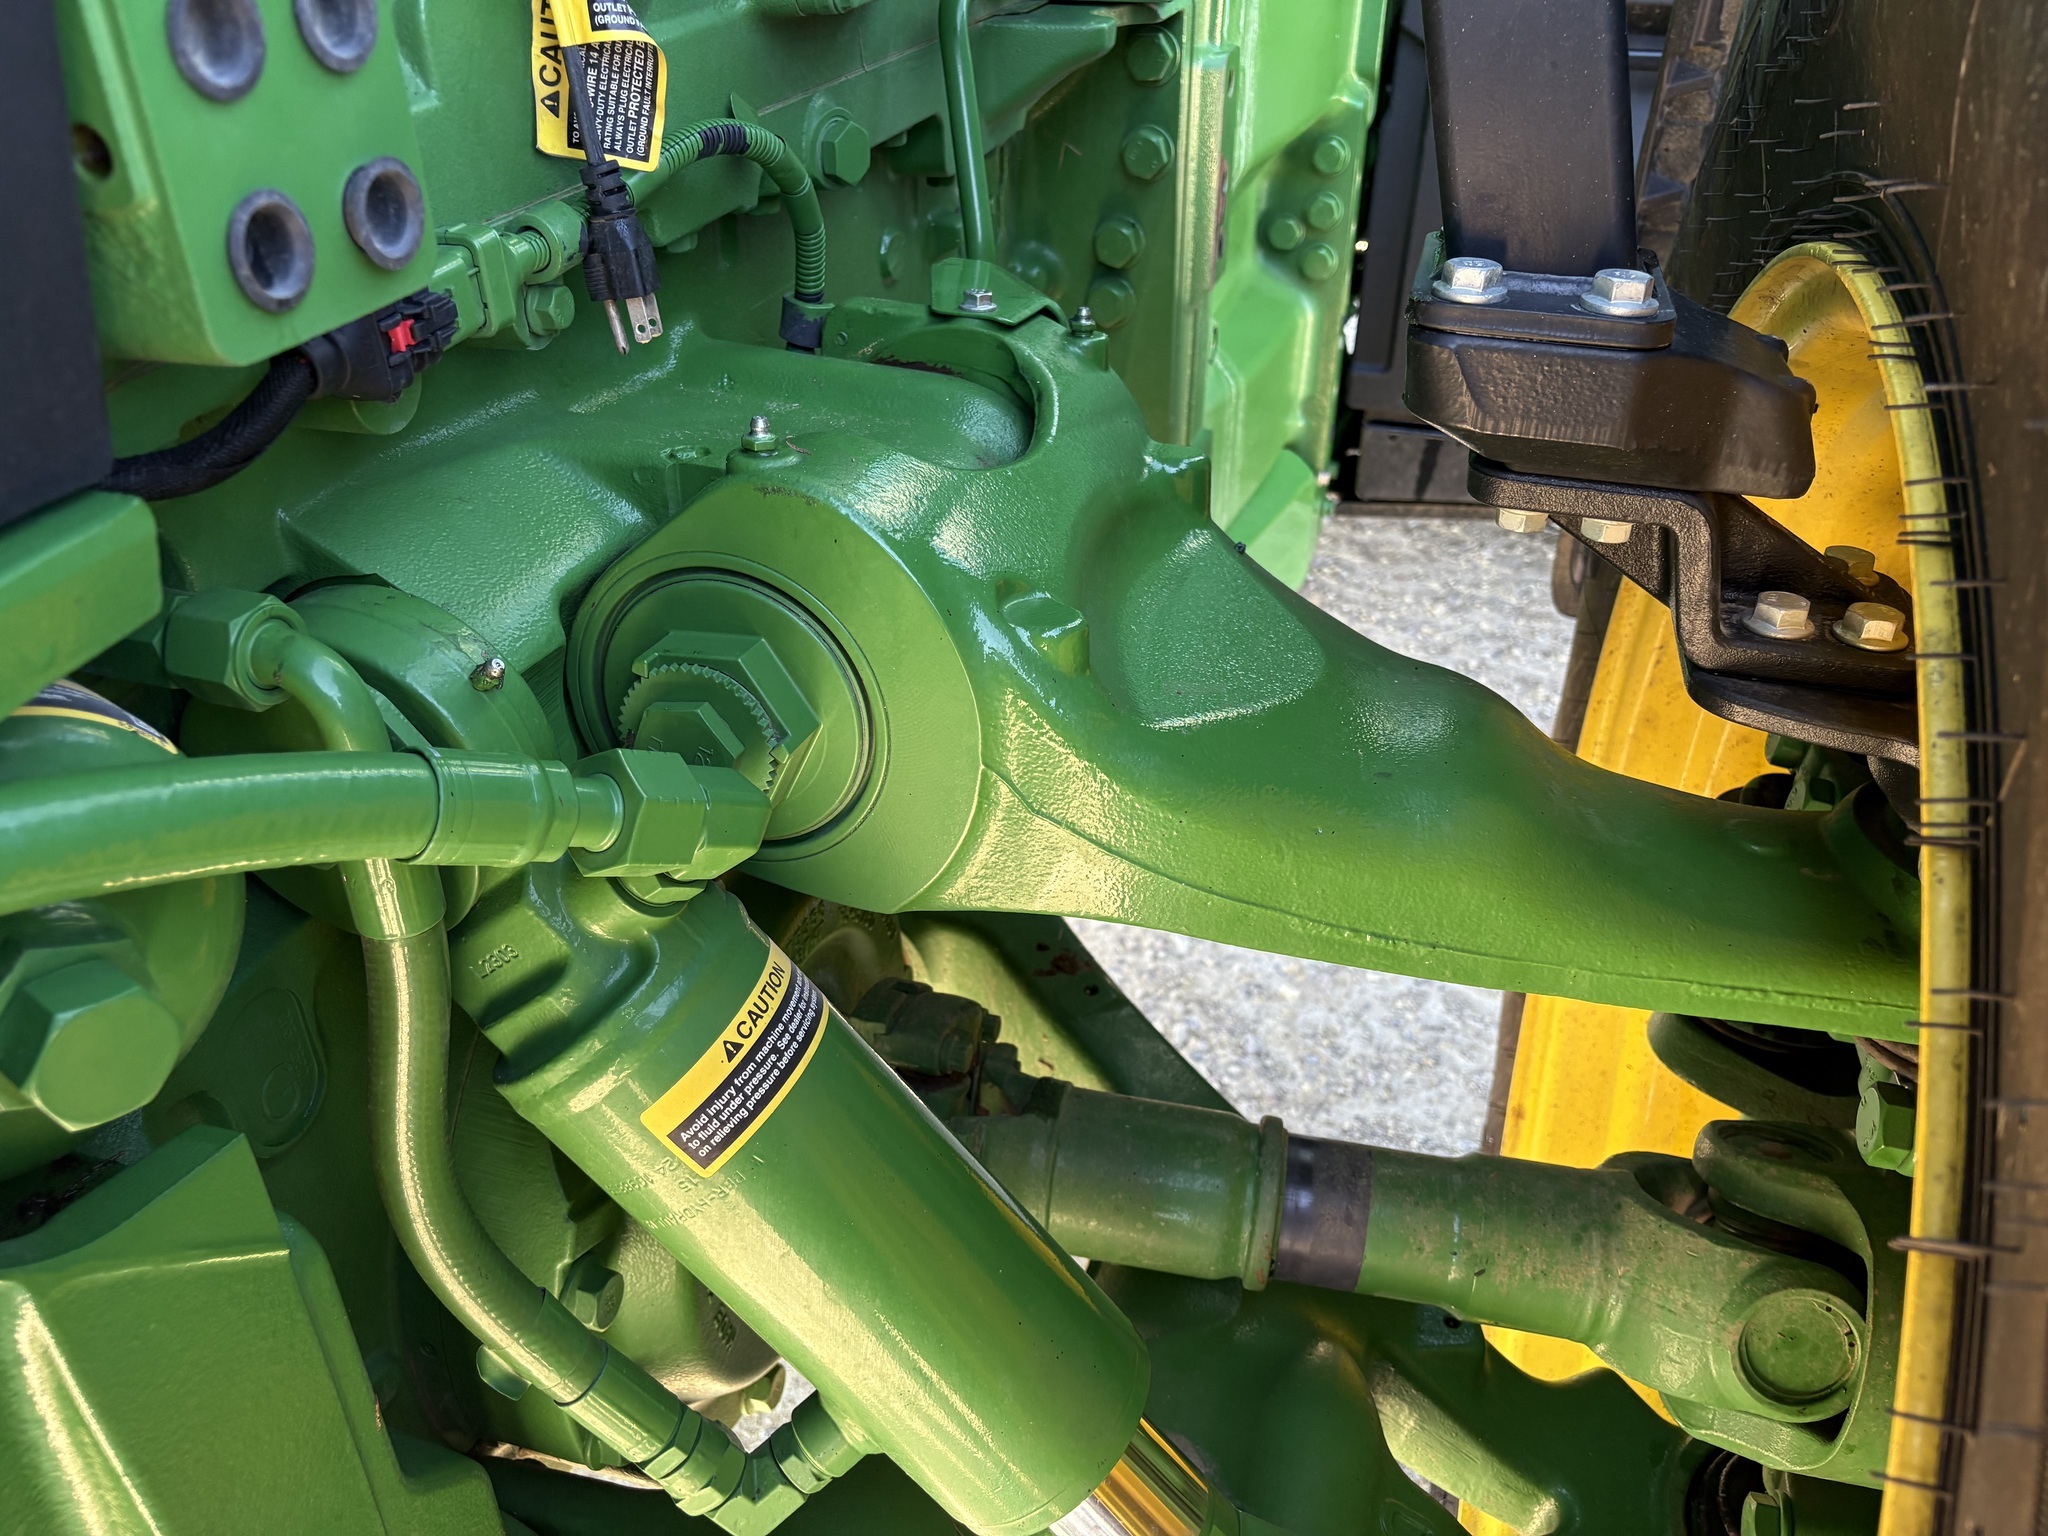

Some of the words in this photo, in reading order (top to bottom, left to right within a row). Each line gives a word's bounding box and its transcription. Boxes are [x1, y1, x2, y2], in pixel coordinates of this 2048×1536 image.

[593, 2, 626, 13] OUTLET
[588, 51, 599, 65] 14
[612, 54, 622, 72] FOR
[607, 74, 619, 116] SUITABLE
[629, 51, 645, 119] PROTECTED
[642, 92, 652, 115] FAULT
[572, 131, 580, 144] TO
[603, 117, 614, 149] RATING
[613, 115, 625, 152] ALWAYS
[619, 90, 629, 114] PLUG
[625, 122, 637, 154] OUTLET
[636, 117, 649, 157] (GROUND
[736, 960, 786, 1039] CAUTION
[679, 1113, 710, 1143] Avoid
[707, 1087, 737, 1116] injury
[733, 1062, 757, 1089] from
[755, 1022, 785, 1064] machine
[782, 984, 802, 1024] movement
[688, 1135, 701, 1150] to
[698, 1116, 720, 1143] fluid
[719, 1092, 745, 1122] under
[743, 1053, 779, 1096] pressure.
[777, 1033, 792, 1051] See
[788, 1009, 804, 1037] dealer
[798, 999, 808, 1012] for
[698, 1143, 712, 1158] on
[711, 1108, 749, 1147] relieving
[746, 1068, 781, 1111] pressure
[777, 1041, 800, 1070] before
[797, 1009, 816, 1046] servicing
